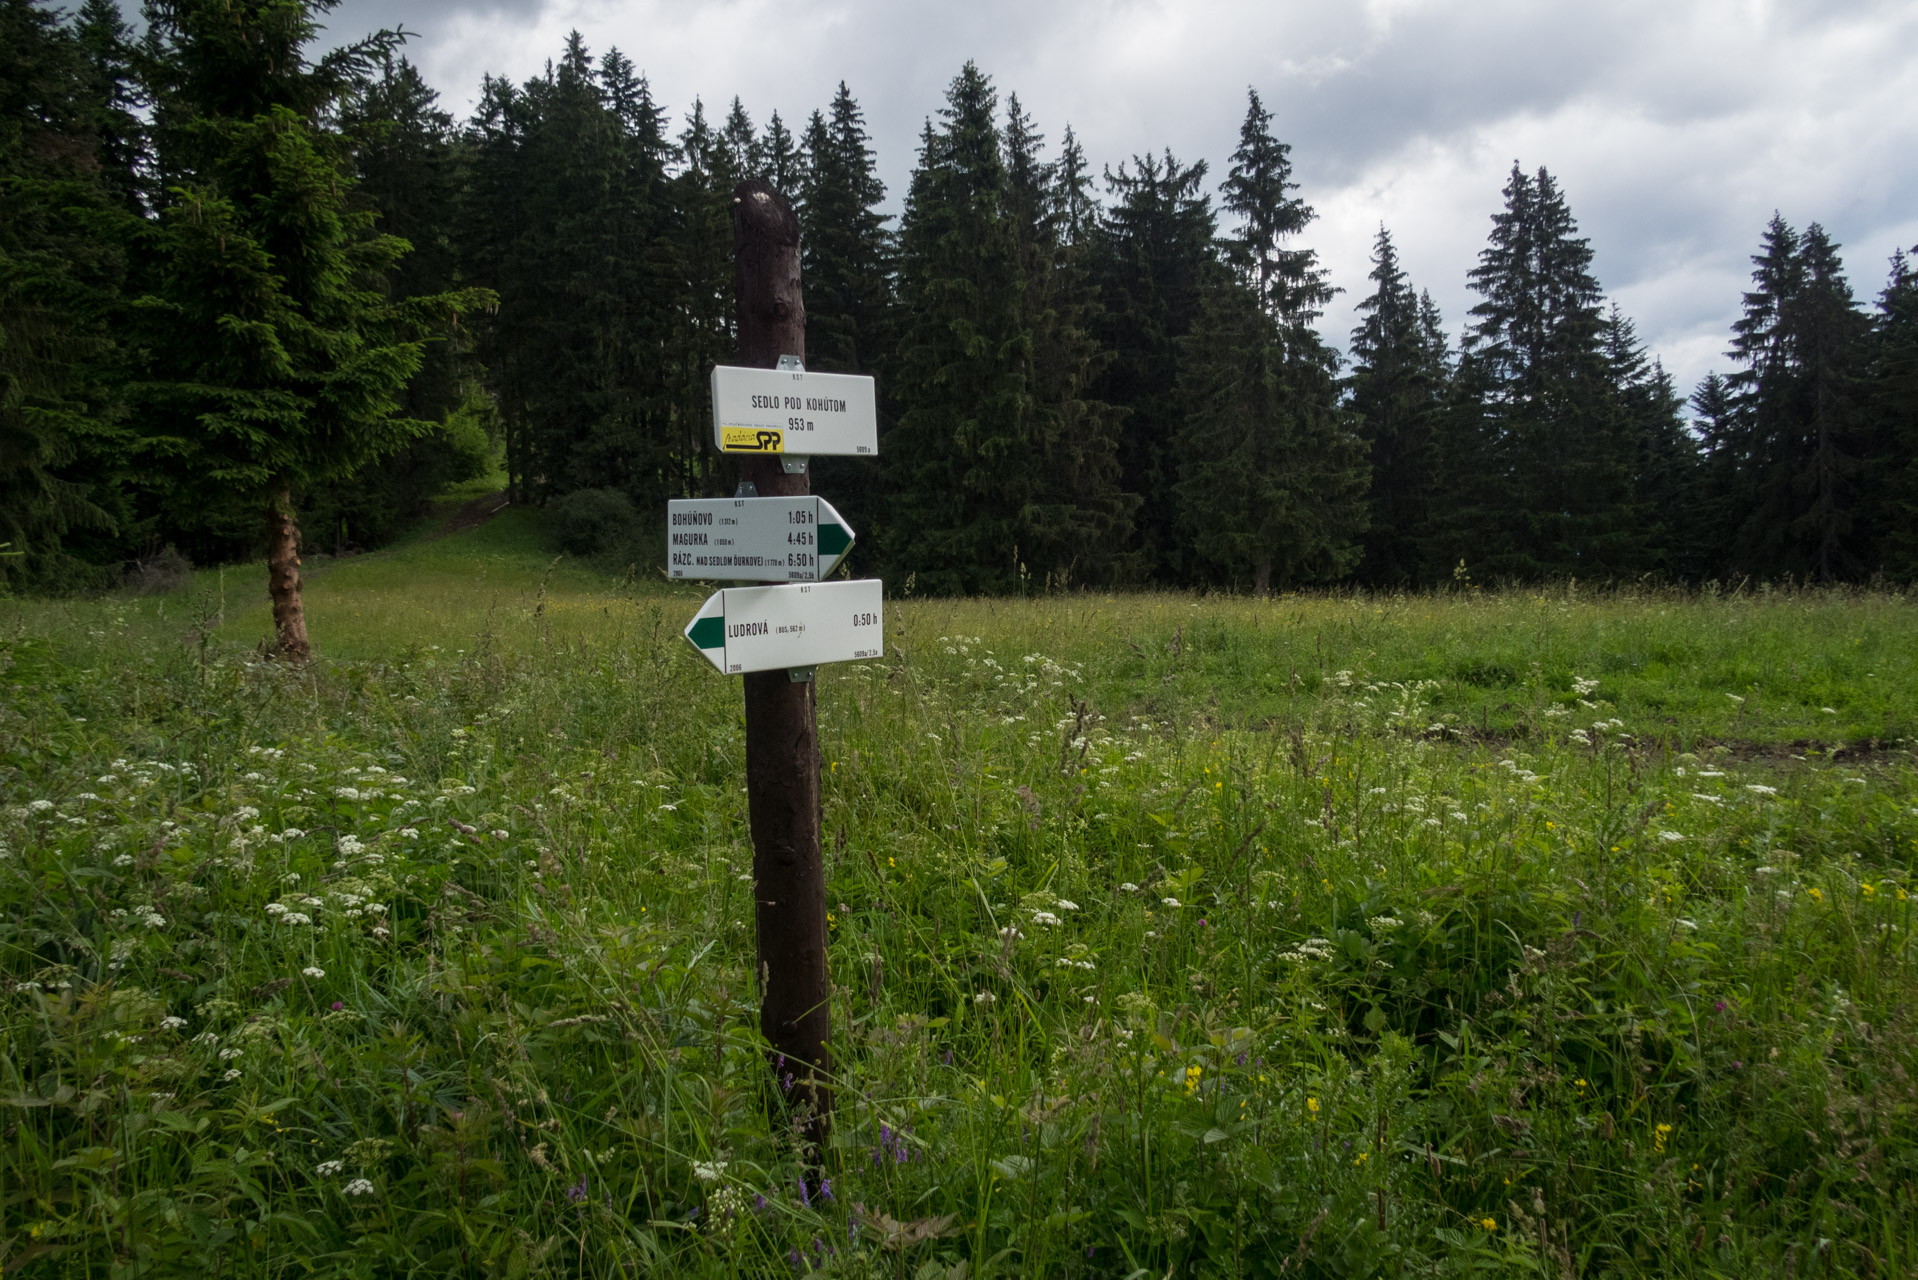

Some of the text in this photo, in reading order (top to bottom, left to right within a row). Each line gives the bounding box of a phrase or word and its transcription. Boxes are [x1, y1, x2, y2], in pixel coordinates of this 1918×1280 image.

[752, 395, 846, 412] SEDLO POD KOHÚTOM
[789, 418, 804, 430] 953
[807, 422, 813, 431] m
[673, 511, 712, 525] BOHÚŇOVO
[789, 511, 806, 524] 1:05
[808, 511, 813, 523] h
[673, 533, 708, 545] MAGURKA
[788, 532, 806, 545] 4:45
[809, 532, 813, 545] h
[673, 551, 694, 566] RÁZC.
[696, 557, 708, 566] NAD
[709, 556, 732, 566] SEDLOM
[788, 554, 807, 566] 6:50
[810, 554, 814, 566] h
[729, 620, 768, 638] LUDROVÁ
[854, 613, 871, 626] 0:50
[873, 613, 877, 624] h
